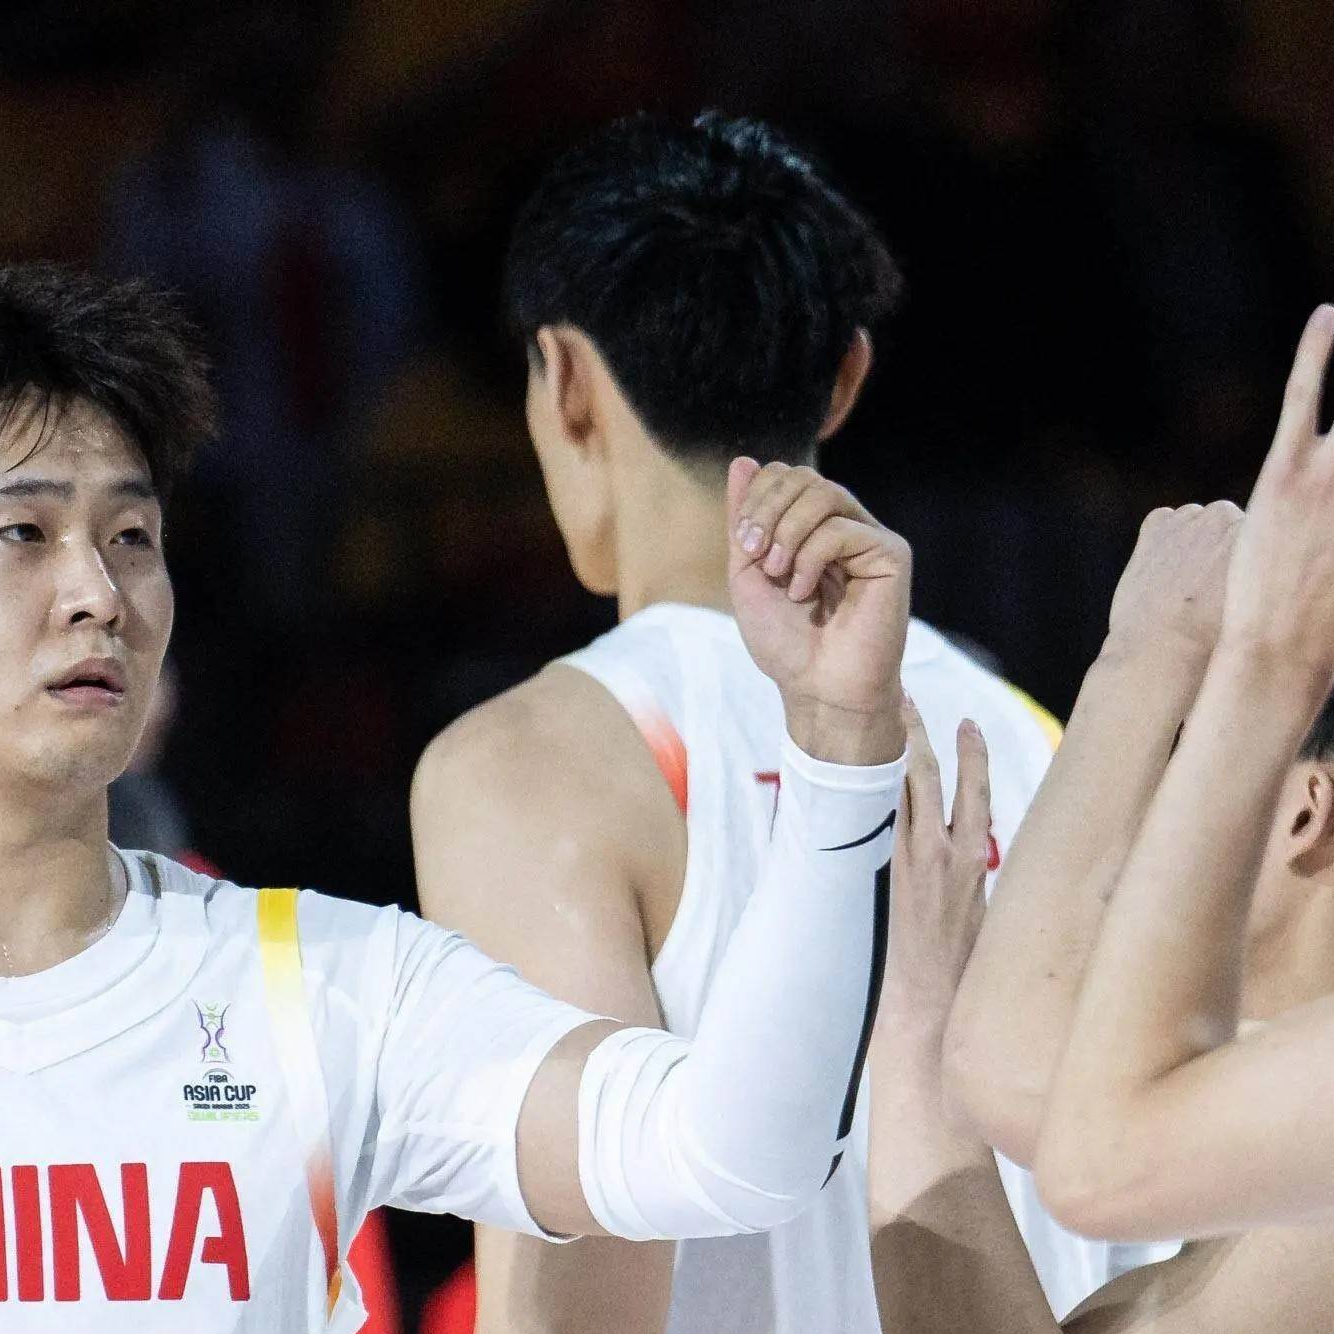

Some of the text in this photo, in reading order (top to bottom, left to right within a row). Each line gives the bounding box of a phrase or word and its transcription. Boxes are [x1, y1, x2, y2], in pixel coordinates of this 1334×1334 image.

[208, 1074, 229, 1083] FIBA
[183, 1084, 257, 1101] ASIA CUP
